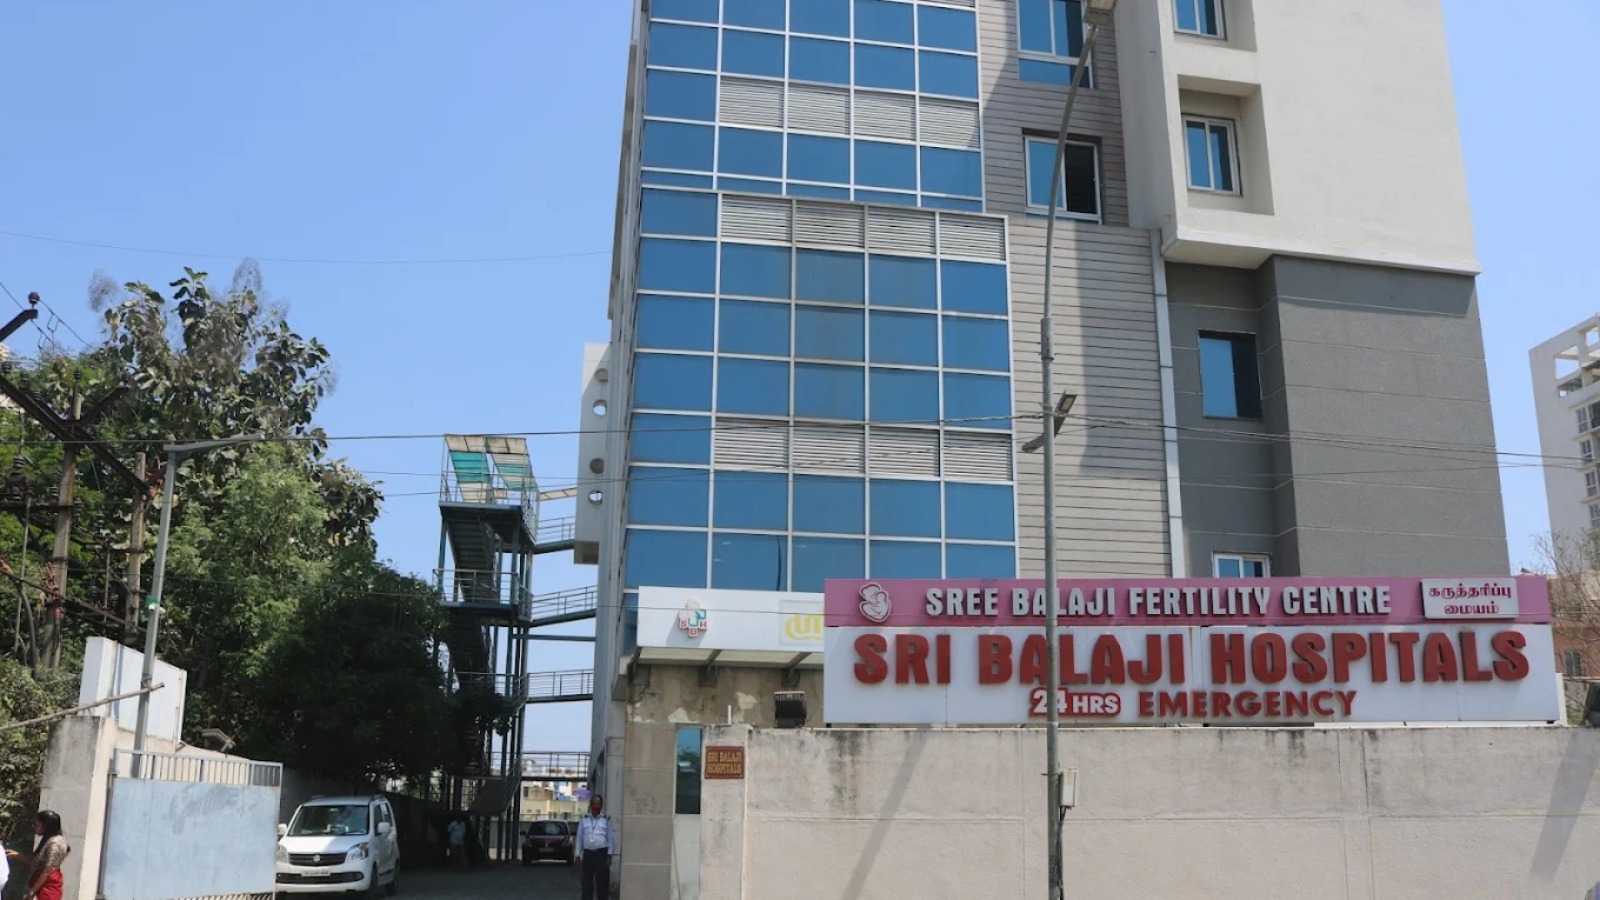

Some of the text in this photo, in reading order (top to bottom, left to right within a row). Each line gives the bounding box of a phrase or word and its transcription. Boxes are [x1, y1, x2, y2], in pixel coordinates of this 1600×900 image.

[926, 585, 1391, 617] SREE BALAJI FERTILITY CENTRE
[1429, 583, 1512, 599] கருத்தரிப்பு
[1444, 600, 1499, 614] மையம்
[853, 630, 1530, 685] SRI BALAJI HOSPITALS
[1072, 695, 1119, 714] HRS
[1138, 691, 1357, 718] EMERGENCY
